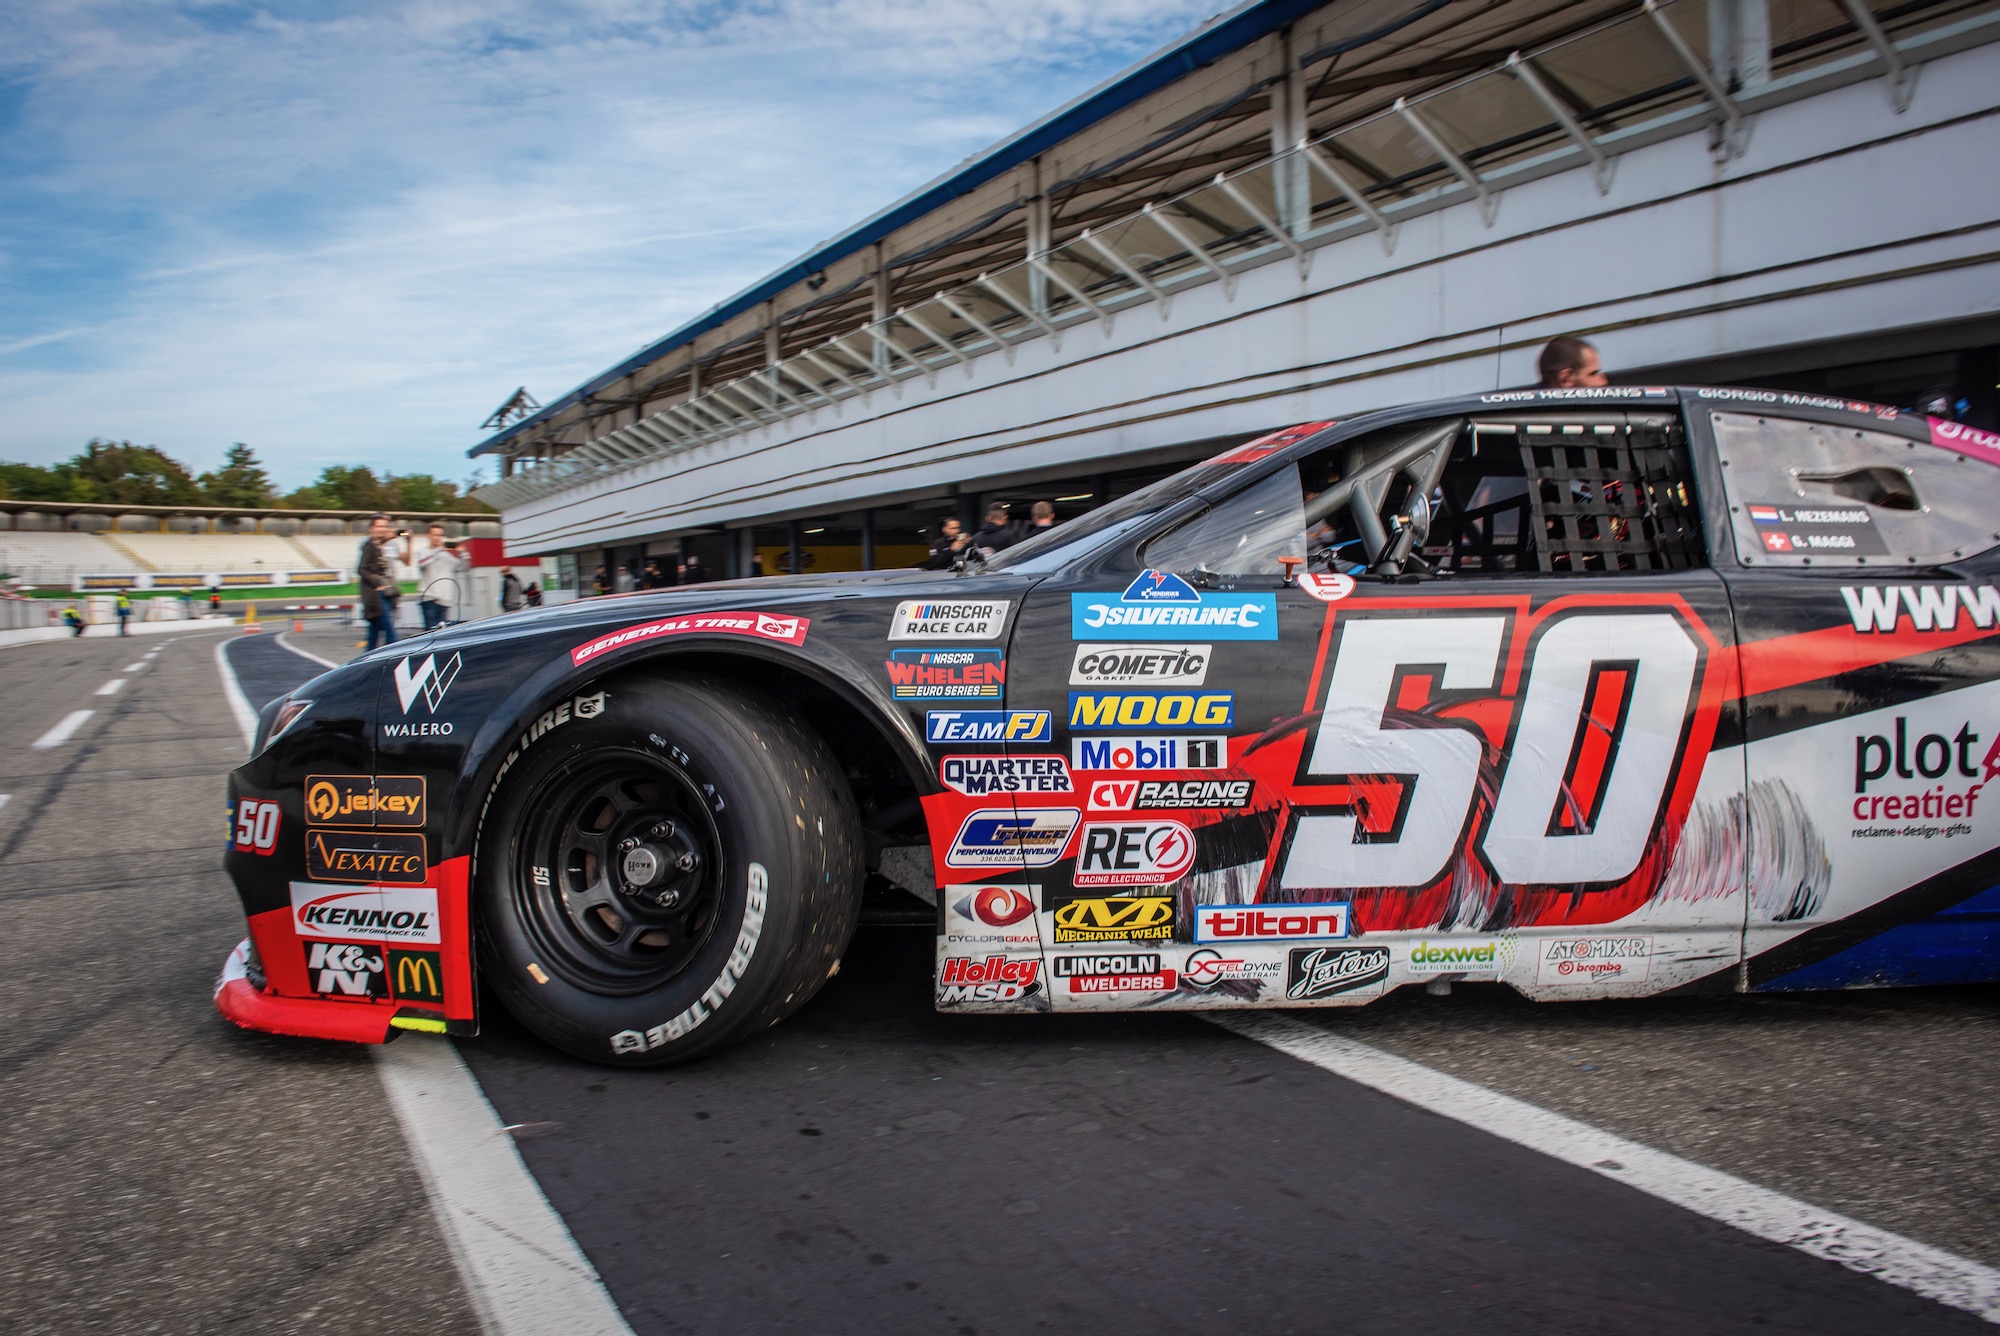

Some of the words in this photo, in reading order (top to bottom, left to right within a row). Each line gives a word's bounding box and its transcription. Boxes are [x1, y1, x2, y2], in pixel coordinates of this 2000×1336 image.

[1480, 391, 1534, 404] LORIS
[1539, 387, 1642, 400] HEZEMANS
[1698, 387, 1777, 403] GIORGIO
[1782, 392, 1845, 410] MAGGI
[1778, 509, 1794, 522] L.
[1794, 510, 1871, 523] HEZEMANS
[1808, 535, 1856, 549] MAGGI
[927, 605, 993, 620] NASCAR
[575, 621, 694, 660] GENERAL
[693, 618, 755, 630] TIRE
[907, 622, 950, 635] RACE
[954, 621, 988, 634] CAR
[932, 652, 975, 665] NASCAR
[1077, 653, 1203, 676] COMETIC
[886, 660, 1006, 686] WHELEN
[916, 685, 944, 696] EURO
[945, 684, 981, 696] SERIES
[1071, 694, 1232, 725] MOOG
[384, 722, 454, 737] WALERO
[1081, 739, 1177, 769] Mobil
[1194, 741, 1210, 768] 1
[1280, 613, 1699, 889] 50
[944, 759, 1064, 784] QUARTER
[967, 774, 1069, 794] MASTER
[1093, 782, 1137, 808] CV
[1139, 781, 1250, 800] RACING
[340, 788, 421, 816] jeikey
[1138, 796, 1249, 808] PRODUCTS
[1853, 784, 1983, 820] creatief
[236, 799, 280, 849] 50
[311, 833, 421, 873] VEXATEC
[956, 848, 1016, 857] PERFORMANCE
[1017, 847, 1060, 856] DRIVELINE
[532, 865, 551, 887] 50
[1078, 874, 1109, 884] RACING
[1110, 873, 1165, 883] ELECTRONICS
[305, 906, 431, 930] KENNOL
[1205, 912, 1339, 936] tilton
[347, 927, 410, 937] PERFORMANCE
[701, 861, 769, 1011] GENERAL
[1055, 927, 1129, 944] MECHANIX
[1129, 926, 1172, 940] WEAR
[308, 943, 385, 974] K&
[1411, 941, 1497, 963] dexwet
[942, 957, 1040, 987] Holley
[1059, 956, 1156, 975] LINCOLN
[1286, 948, 1389, 999] Jostens
[1576, 962, 1622, 973] brembo
[317, 969, 370, 995] N
[941, 984, 1025, 1002] MSD
[1080, 976, 1165, 991] WELDERS
